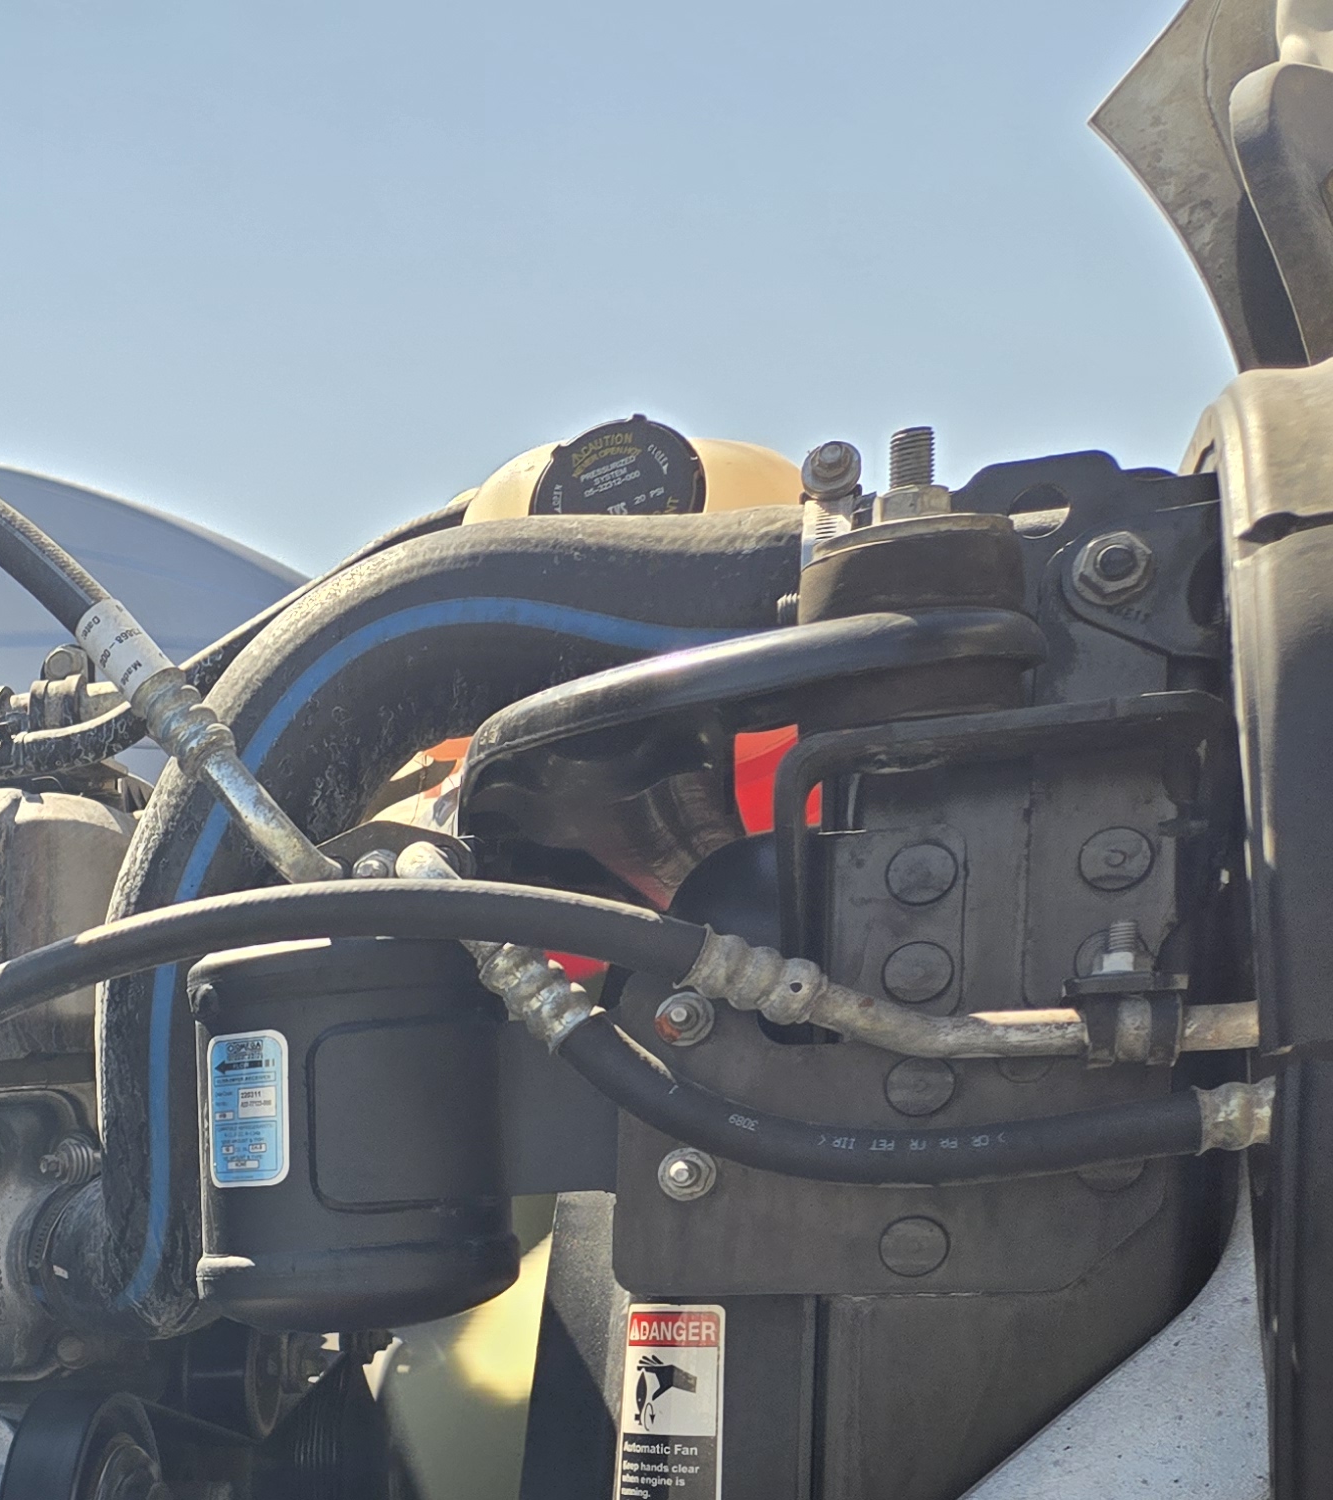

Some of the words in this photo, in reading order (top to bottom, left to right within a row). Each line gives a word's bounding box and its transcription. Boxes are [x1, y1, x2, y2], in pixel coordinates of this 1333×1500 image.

[583, 431, 633, 456] CAUTION
[580, 455, 636, 483] PRESSURIZED
[593, 467, 627, 486] SYSTEM
[81, 615, 101, 640] Date:
[120, 660, 142, 685] Made
[728, 1113, 759, 1132] 3089
[640, 1321, 716, 1341] DANGER
[623, 1441, 671, 1455] Automatic
[674, 1444, 698, 1456] Fan
[622, 1460, 639, 1472] Keep
[640, 1462, 669, 1473] hands
[672, 1464, 700, 1473] clear
[640, 1476, 673, 1487] engine
[675, 1476, 686, 1486] is
